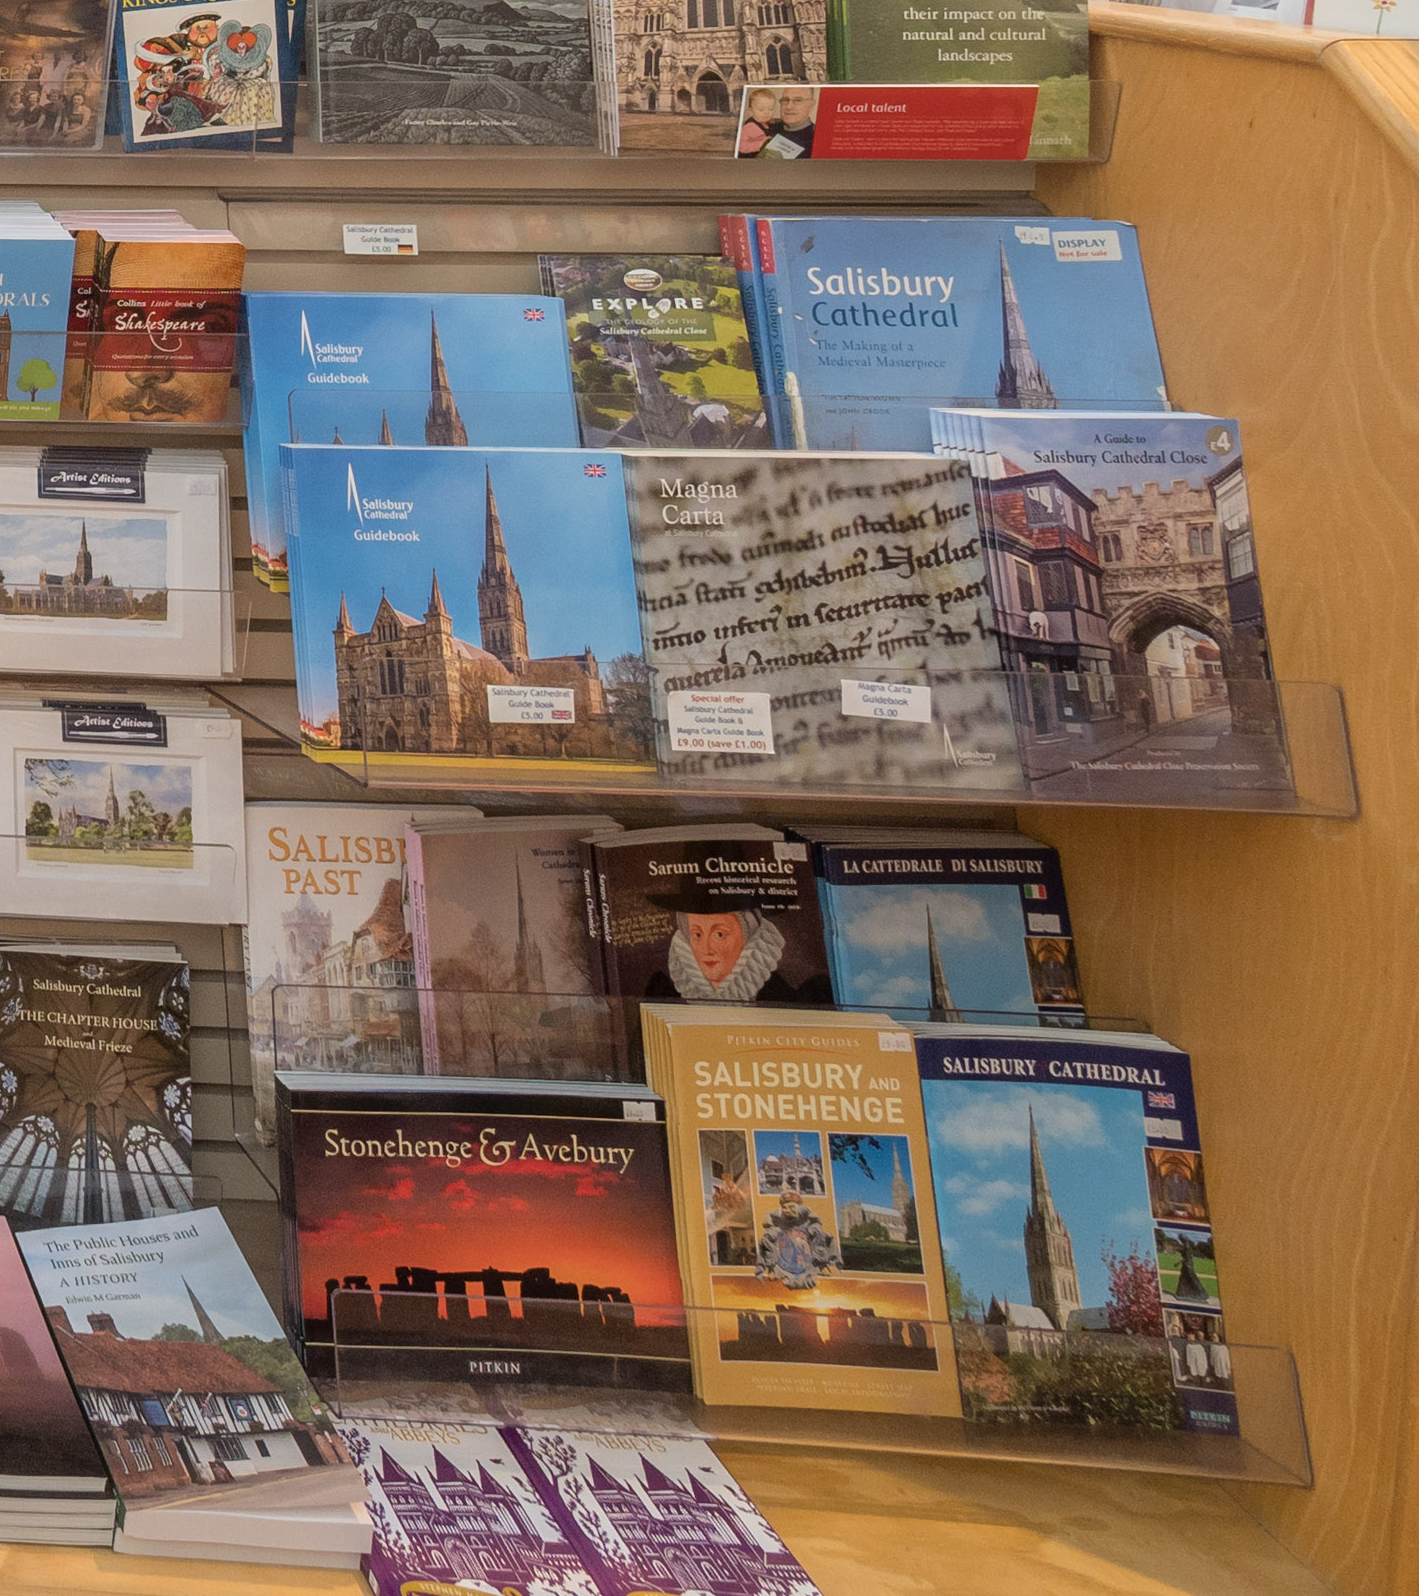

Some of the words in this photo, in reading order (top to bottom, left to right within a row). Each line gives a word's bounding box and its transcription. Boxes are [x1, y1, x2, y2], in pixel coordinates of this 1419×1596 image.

[903, 7, 938, 20] their
[943, 8, 995, 23] impact
[999, 10, 1016, 20] on
[1021, 7, 1045, 20] the
[902, 27, 954, 41] natural
[958, 27, 986, 41] and
[989, 27, 1046, 41] cultural
[937, 47, 1013, 64] landscapes
[837, 103, 868, 113] Local
[871, 103, 907, 113] talent
[1058, 238, 1106, 249] DISPLAY
[807, 267, 955, 303] Salisbury
[813, 301, 958, 328] Cathedral
[600, 327, 639, 336] Salisbury
[641, 327, 682, 335] Cathedral
[684, 327, 707, 335] Close
[315, 343, 364, 356] Salisbury
[317, 355, 358, 363] Cathedral
[818, 355, 872, 368] Medieval
[876, 357, 947, 370] Masterpiece
[307, 373, 370, 384] Guidebook
[1034, 451, 1097, 466] Salisbury
[1101, 451, 1165, 464] Cathedral
[1170, 451, 1208, 464] Close
[661, 477, 737, 502] Magna
[363, 499, 414, 513] Salisbury
[663, 504, 725, 526] Carta
[354, 529, 420, 542] Guidebook
[858, 683, 885, 693] Magna
[888, 685, 912, 694] Carta
[691, 694, 721, 704] Special
[862, 695, 908, 705] Guidebook
[649, 860, 700, 876] Sarum
[705, 856, 794, 874] Chronicle
[843, 860, 860, 873] LA
[863, 860, 943, 873] CATTEDRALE
[952, 859, 968, 872] DI
[969, 860, 1043, 874] SALISBURY
[283, 869, 362, 896] PAST
[32, 979, 84, 996] Salisbury
[86, 983, 141, 998] Cathedral
[18, 1009, 45, 1022] THE
[47, 1011, 110, 1029] CHAPTER
[113, 1016, 158, 1031] HOUSE
[43, 1034, 95, 1052] Medieval
[97, 1039, 132, 1054] Frieze
[694, 1061, 863, 1089] SALISBURY
[868, 1077, 900, 1091] AND
[943, 1056, 1036, 1076] SALISBURY
[1048, 1061, 1166, 1087] CATHEDRAL
[696, 1093, 905, 1124] STONEHENGE
[324, 1129, 472, 1168] Stonehenge
[479, 1128, 516, 1166] &
[519, 1133, 635, 1175] Avebury
[44, 1240, 70, 1253] The
[73, 1236, 118, 1251] Public
[119, 1232, 170, 1247] Houses
[173, 1225, 199, 1239] and
[50, 1259, 81, 1270] Inns
[84, 1255, 97, 1266] of
[100, 1252, 164, 1266] Salisbury
[60, 1278, 70, 1287] A
[75, 1273, 138, 1286] HISTORY
[469, 1361, 521, 1375] PITKIN
